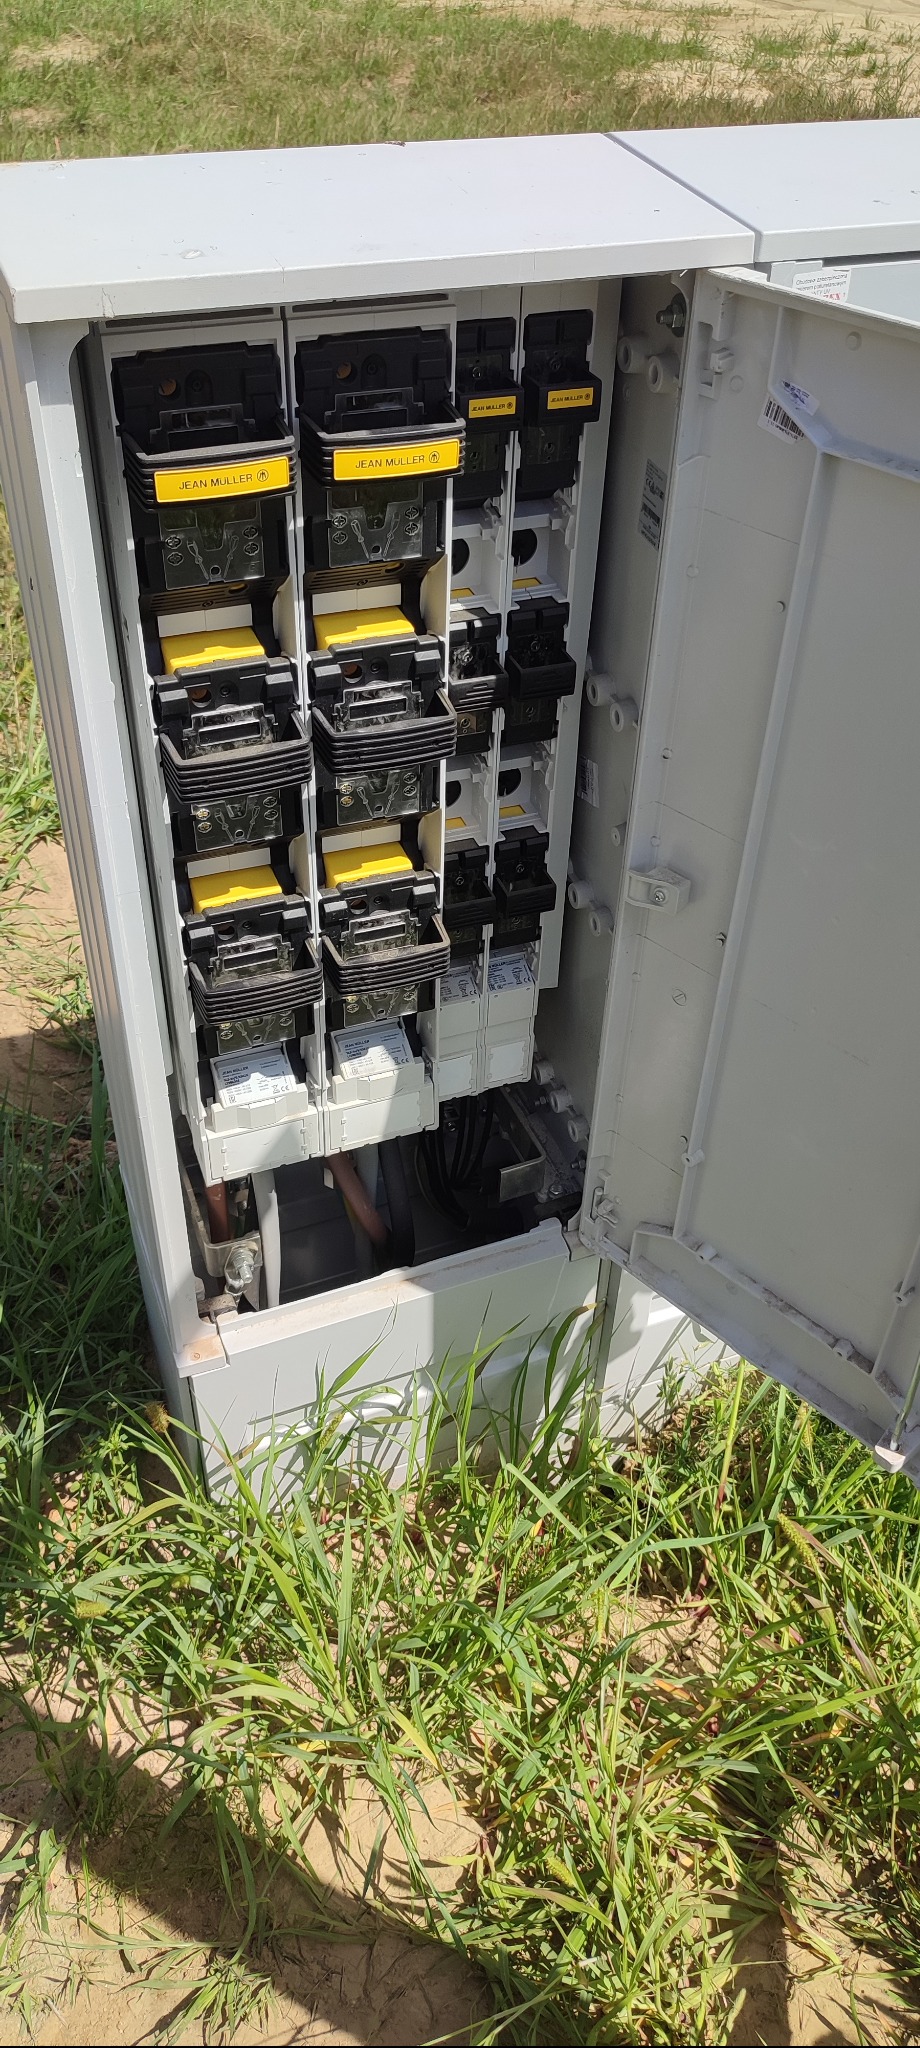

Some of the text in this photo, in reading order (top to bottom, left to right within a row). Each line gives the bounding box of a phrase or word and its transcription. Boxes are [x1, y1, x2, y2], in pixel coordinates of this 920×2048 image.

[355, 454, 425, 469] JEAN MÜLLER
[178, 479, 207, 490] JEAN
